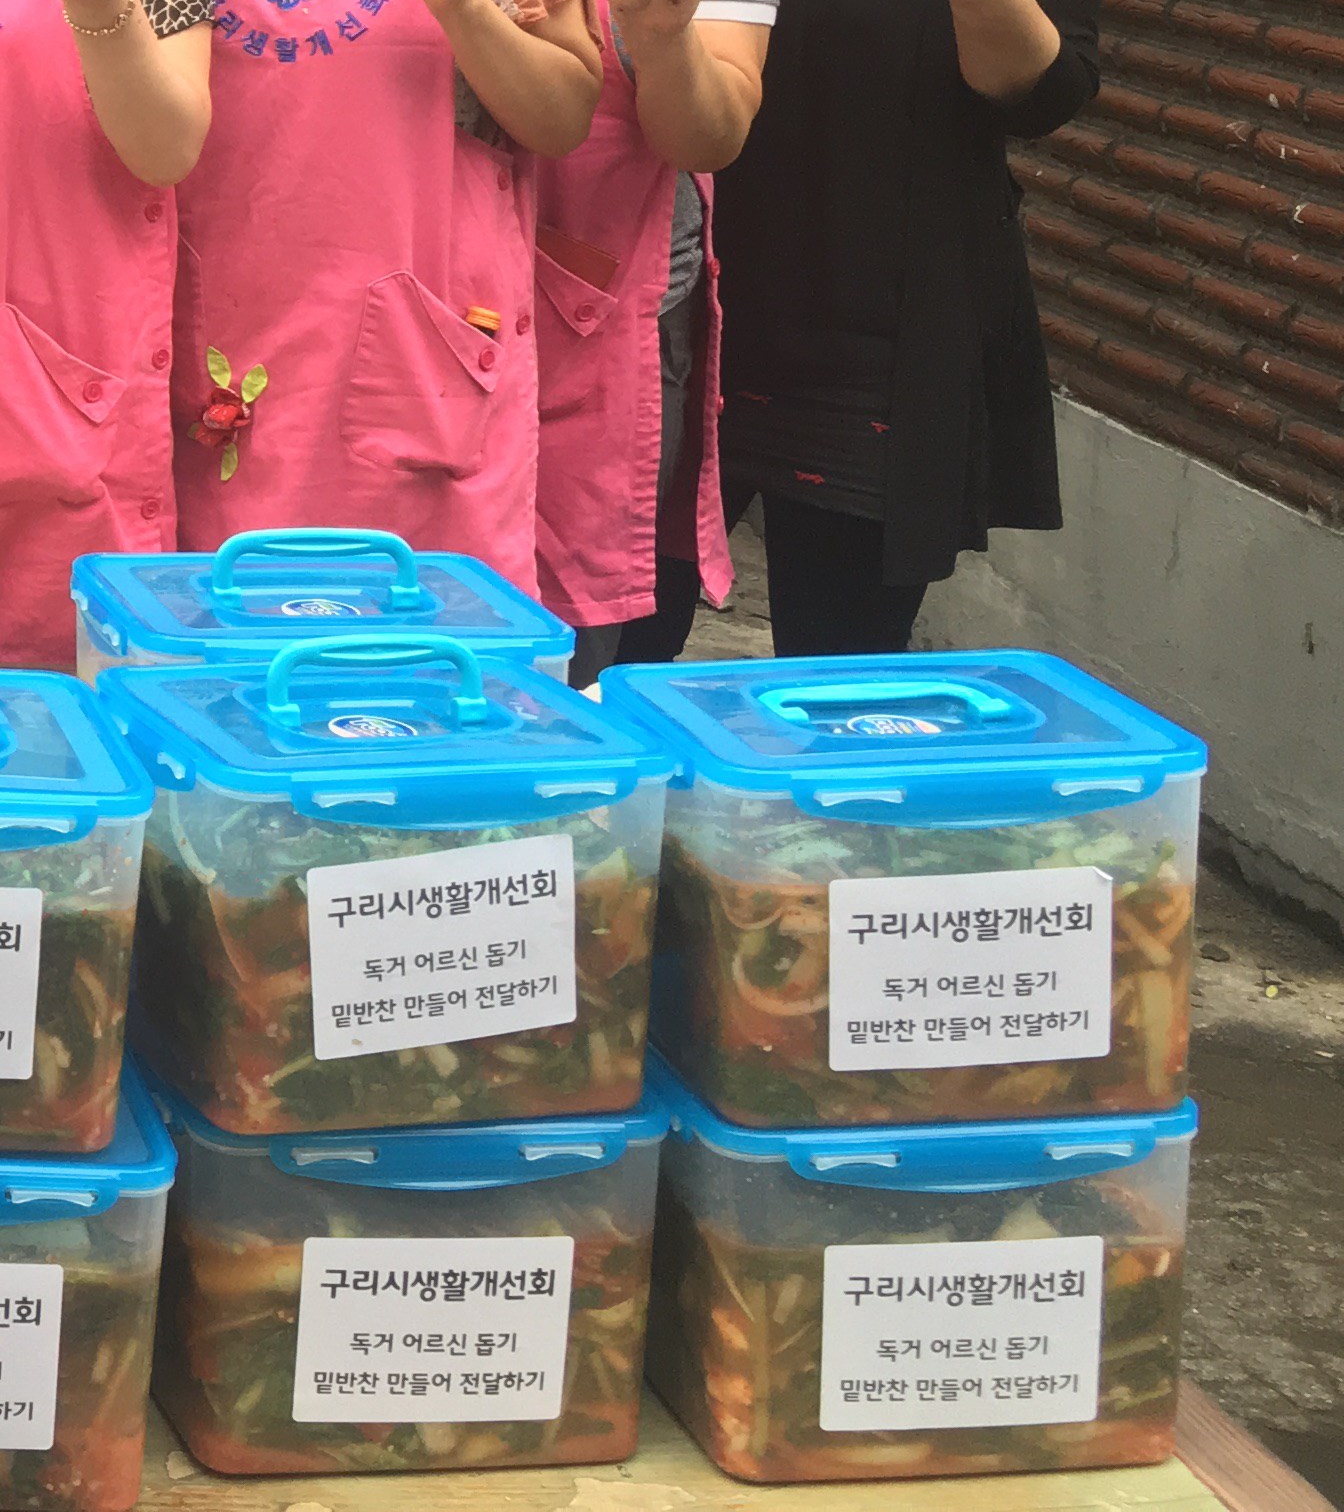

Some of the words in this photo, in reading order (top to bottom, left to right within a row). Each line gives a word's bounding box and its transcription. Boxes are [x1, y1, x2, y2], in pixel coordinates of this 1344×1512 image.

[328, 869, 556, 928] 구리시생활개선회
[848, 903, 1092, 944] 구리시생활개선회
[364, 956, 405, 981] 독거
[415, 947, 477, 972] 어르신
[486, 940, 525, 967] 돕기
[332, 999, 396, 1028] 밑반찬
[405, 990, 466, 1018] 만들어
[476, 976, 556, 1009] 전달하기
[883, 978, 927, 1001] 독거
[938, 975, 1003, 997] 어르신
[1014, 972, 1056, 996] 돕기
[848, 1019, 916, 1044] 밑반찬
[925, 1016, 990, 1041] 만들어
[1001, 1011, 1088, 1037] 전달하기
[321, 1268, 555, 1301] 구리시생활개선회
[845, 1270, 1084, 1306] 구리시생활개선회
[351, 1333, 393, 1355] 독거
[403, 1334, 466, 1356] 어르신
[475, 1333, 516, 1356] 돕기
[878, 1340, 920, 1362] 독거
[931, 1338, 996, 1360] 어르신
[1006, 1336, 1047, 1360] 돕기
[314, 1372, 379, 1394] 밑반찬
[388, 1374, 451, 1395] 만들어
[461, 1372, 544, 1395] 전달하기
[841, 1379, 908, 1402] 밑반찬
[917, 1379, 982, 1401] 만들어
[992, 1375, 1078, 1399] 전달하기
